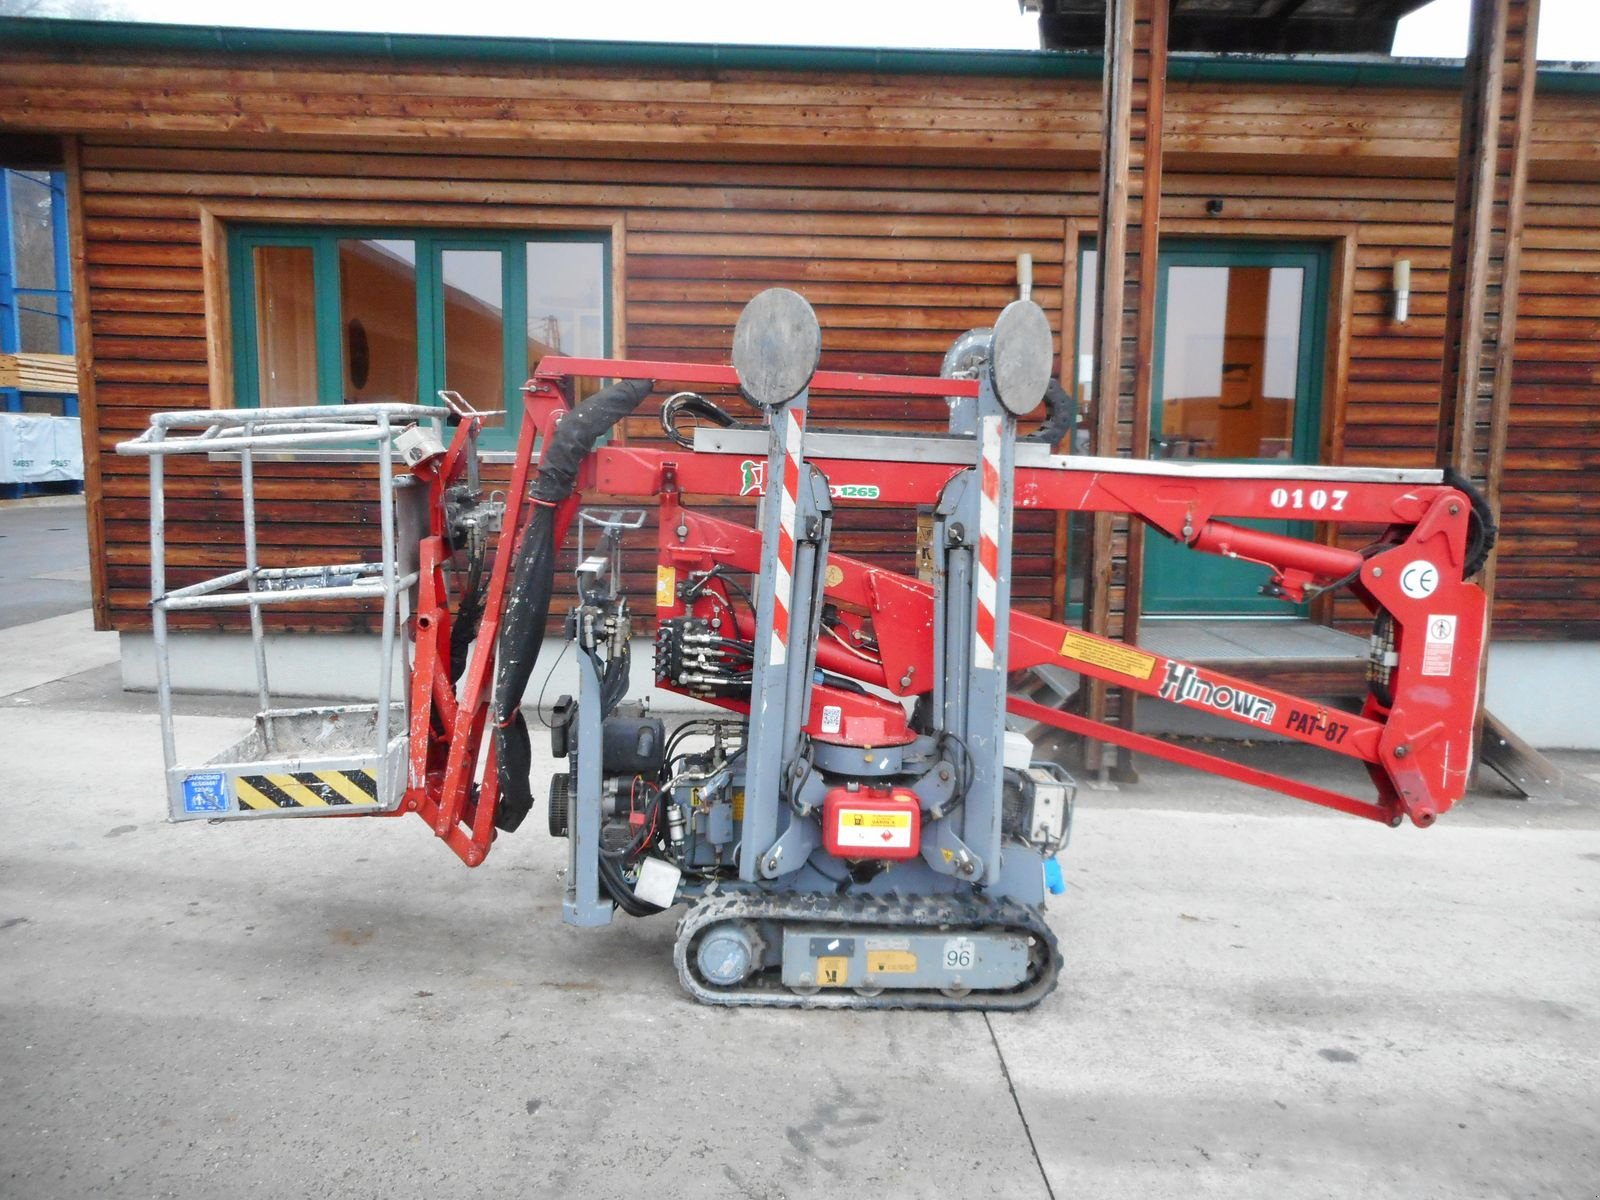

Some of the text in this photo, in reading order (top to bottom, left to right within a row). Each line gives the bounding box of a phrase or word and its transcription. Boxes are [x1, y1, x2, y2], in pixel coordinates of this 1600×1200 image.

[841, 485, 878, 498] 1265
[1270, 488, 1349, 512] 0107
[1402, 568, 1433, 593] CE
[1285, 709, 1350, 745] PAT-87
[946, 950, 970, 967] 96
